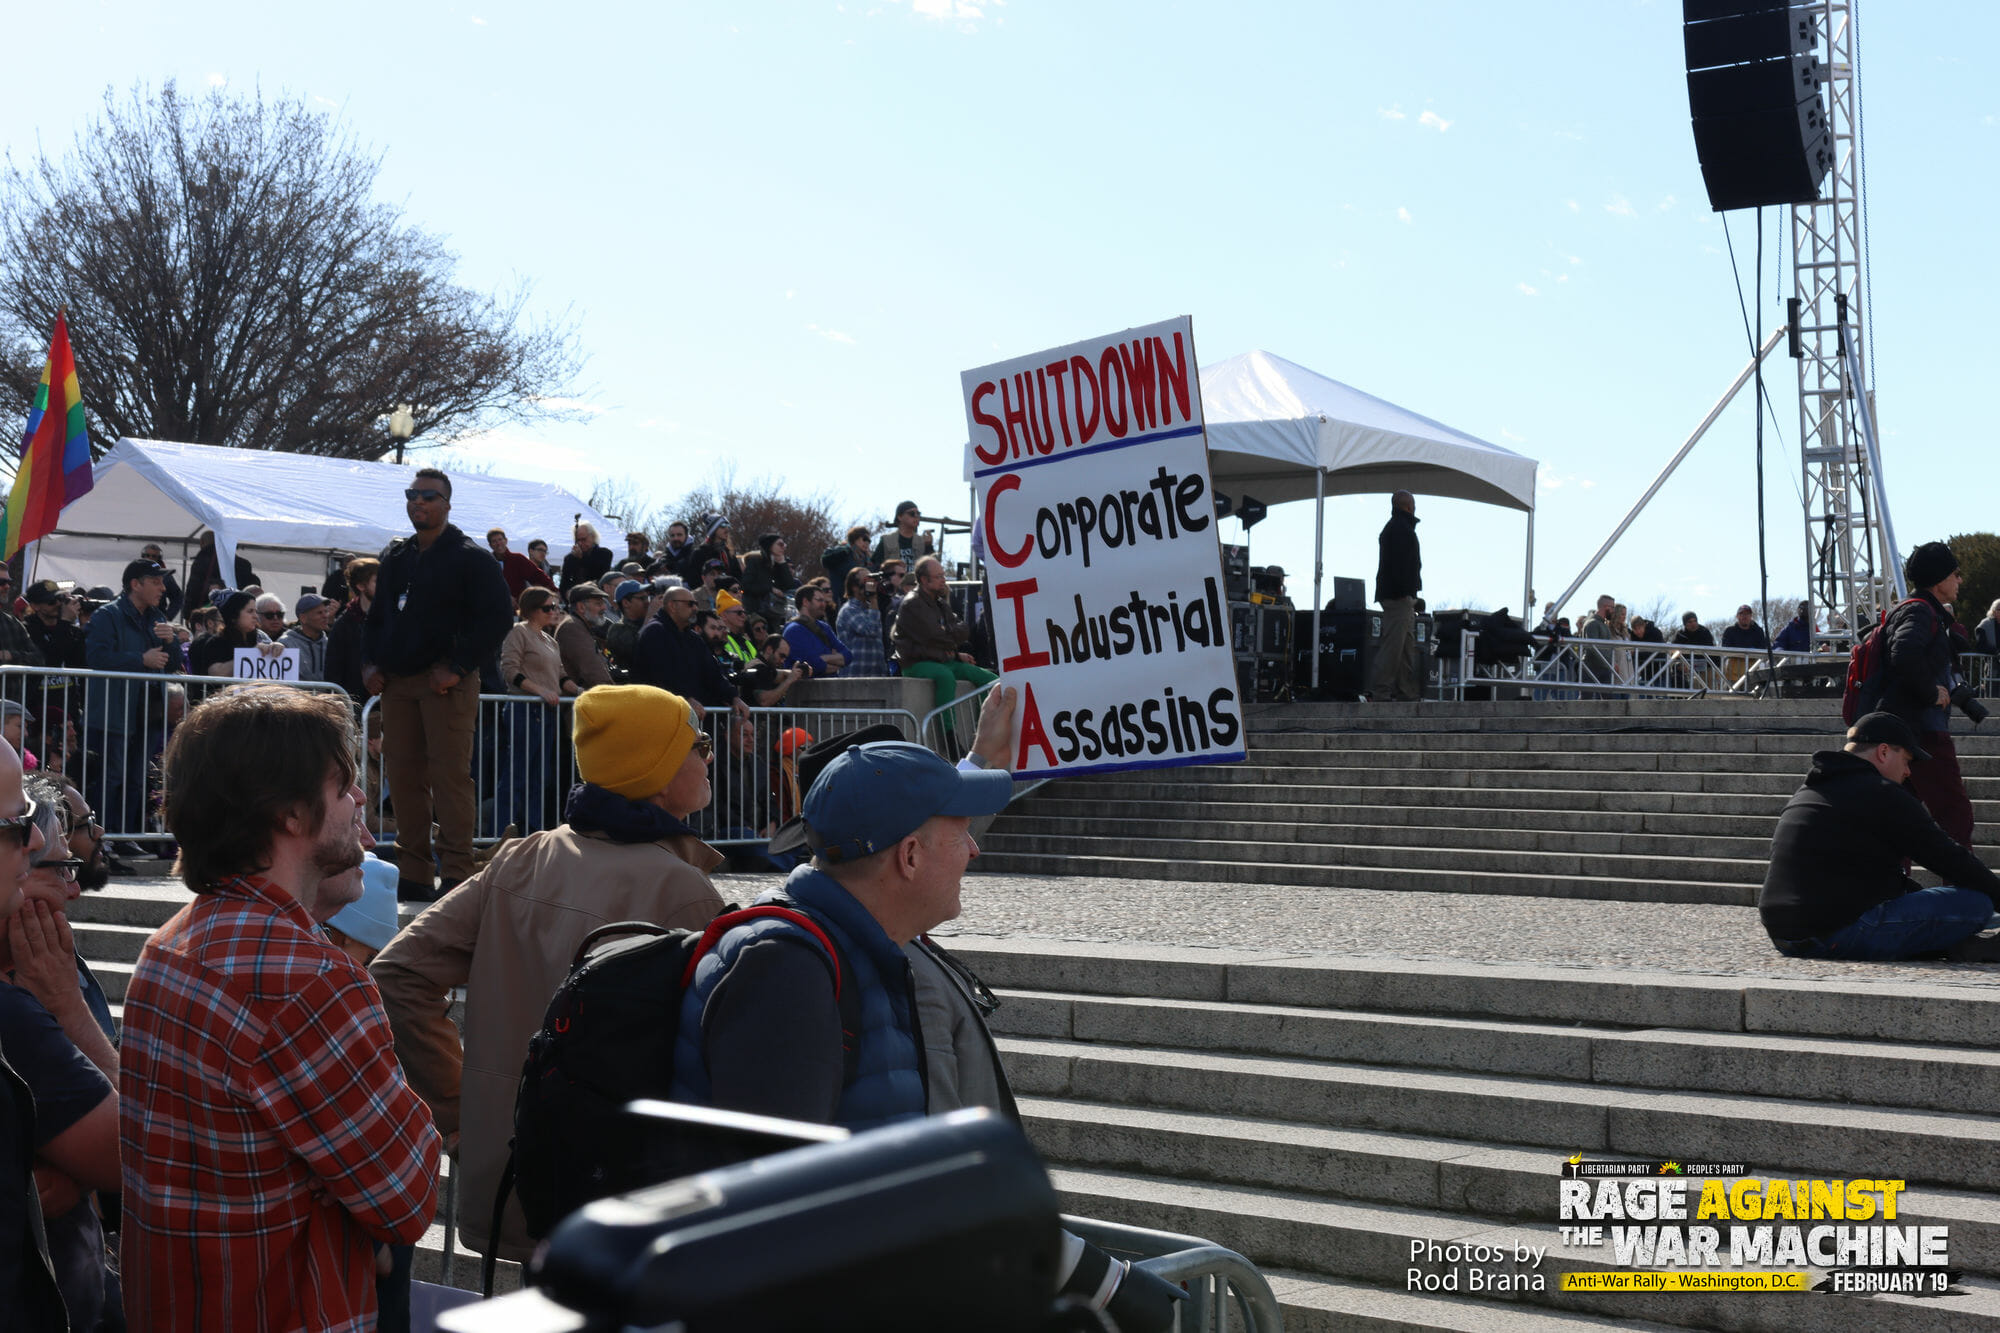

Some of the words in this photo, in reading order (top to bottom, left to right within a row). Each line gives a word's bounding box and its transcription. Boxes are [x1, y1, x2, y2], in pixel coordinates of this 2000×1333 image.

[971, 332, 1192, 466] SHUTDOWN
[984, 466, 1209, 568] Corporate
[240, 656, 293, 680] DROP
[995, 577, 1225, 672] Industrial
[1016, 681, 1239, 770] Assassins
